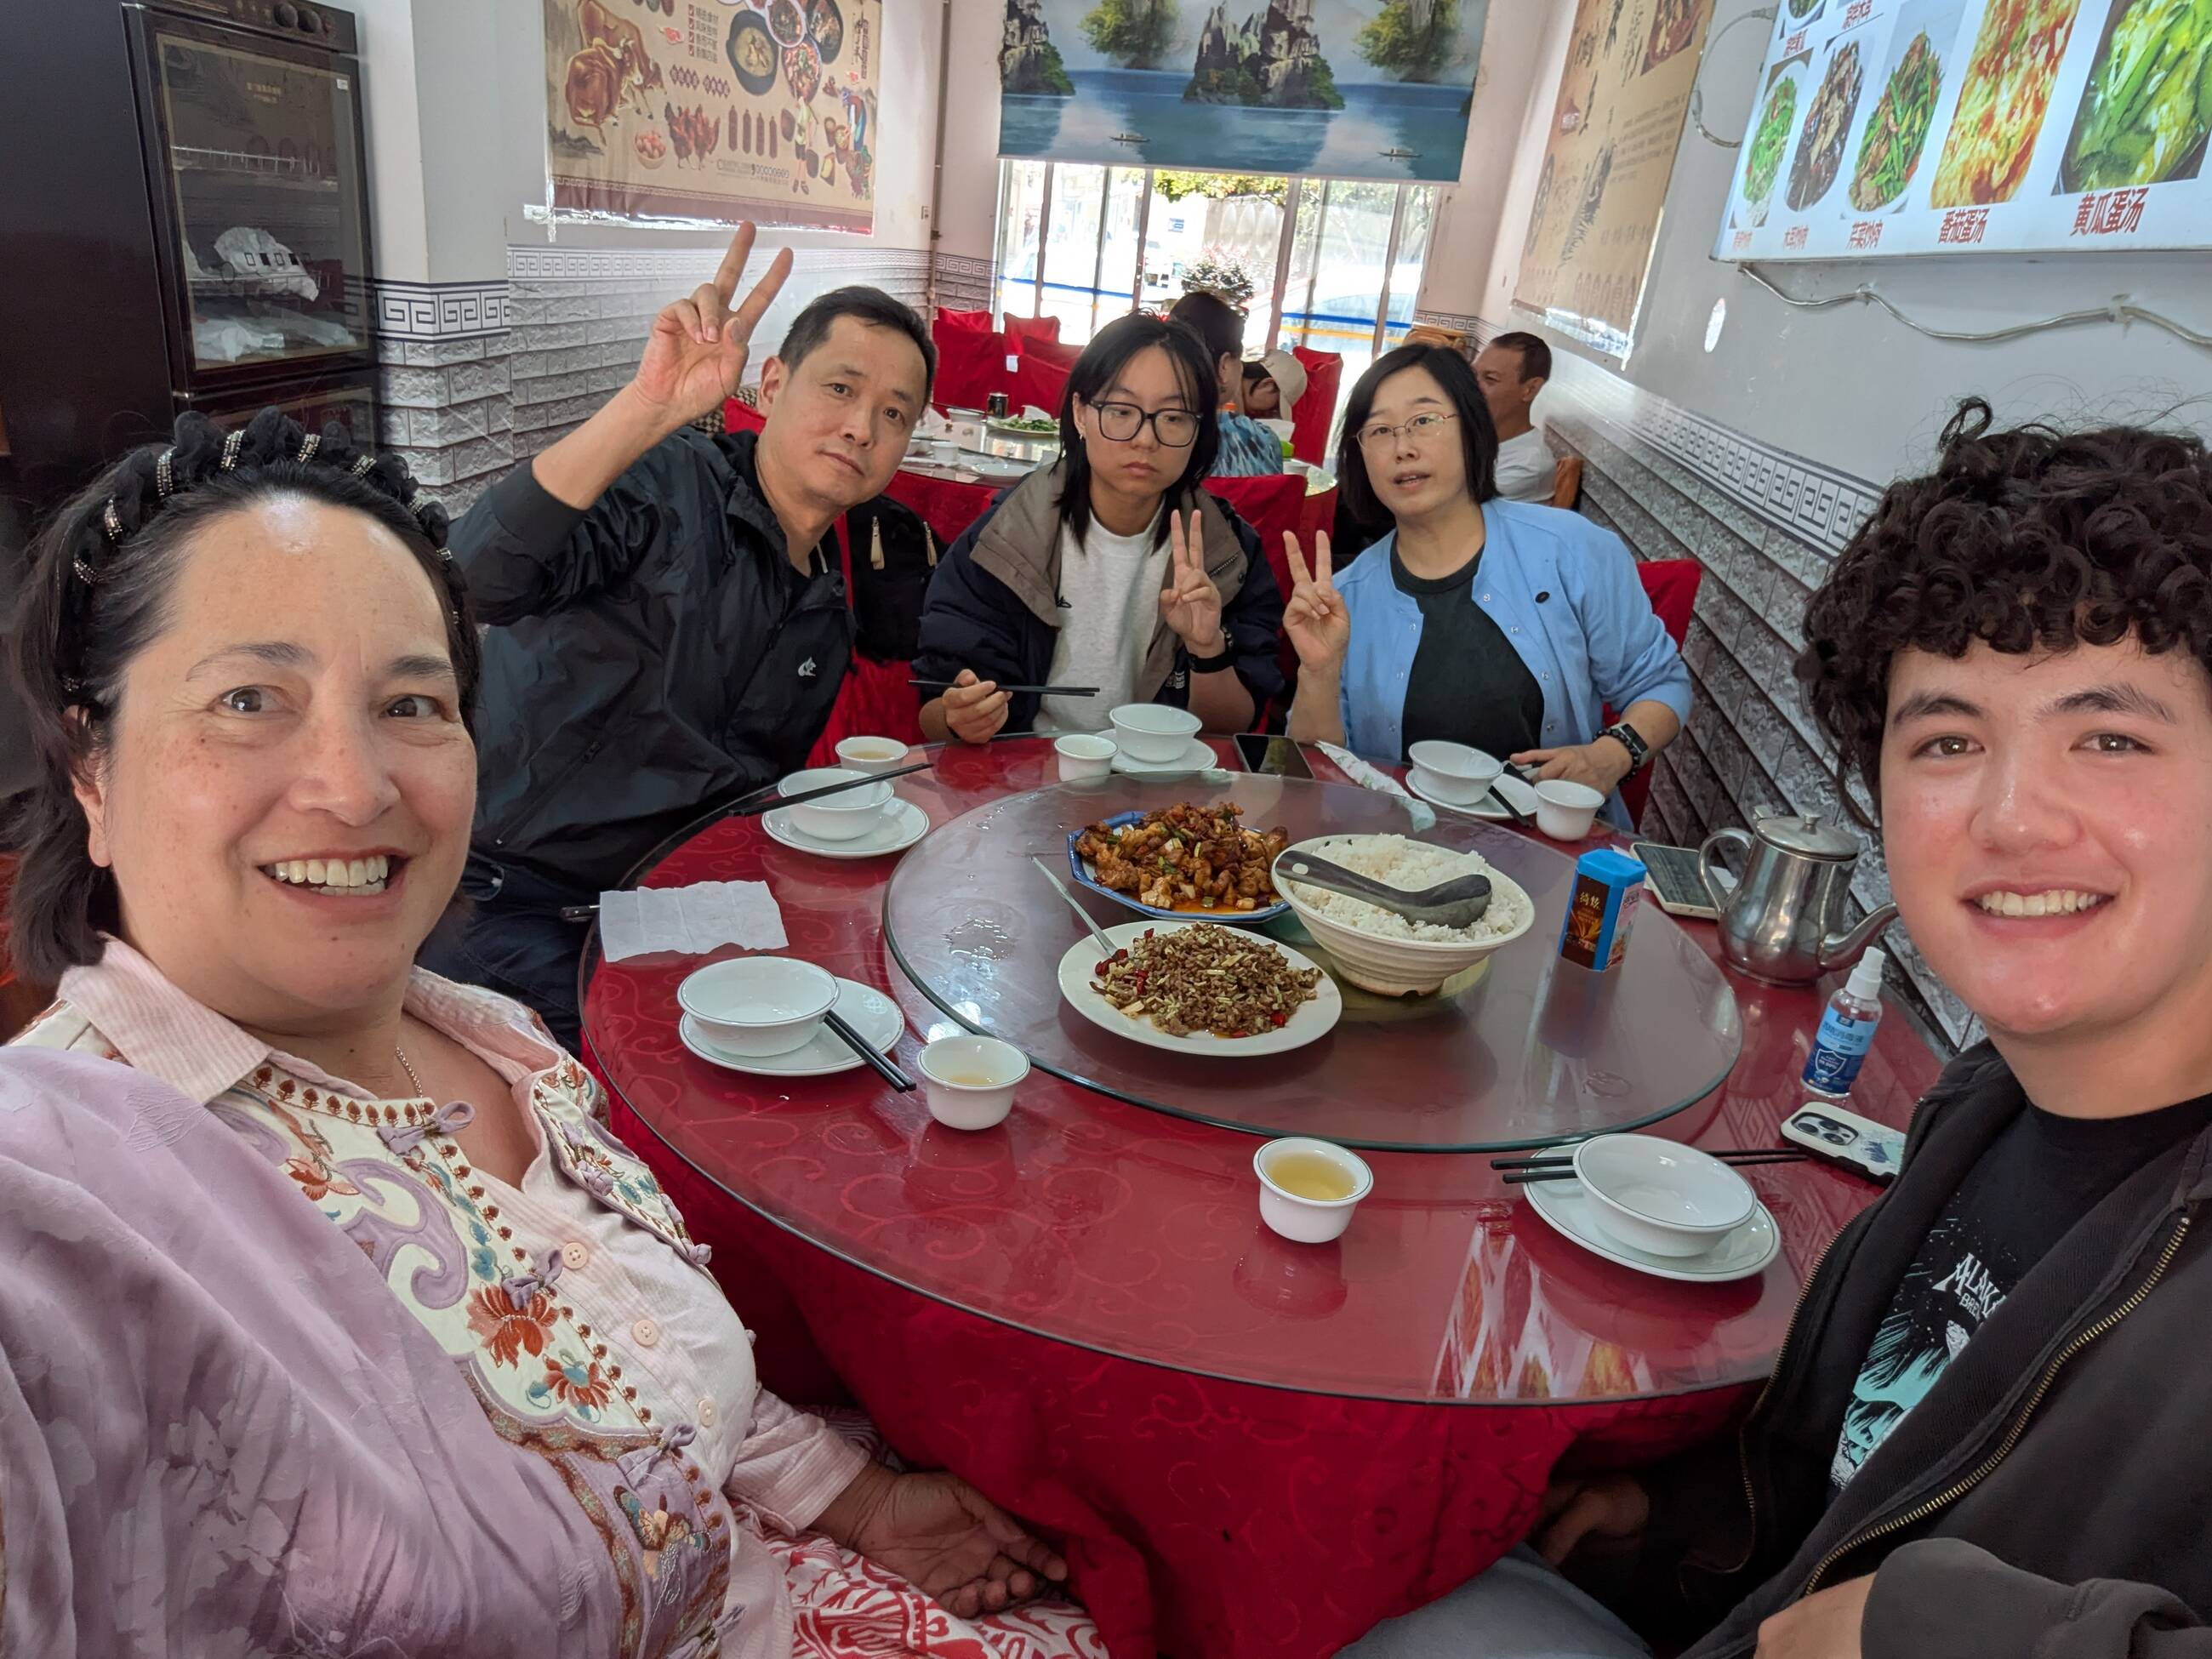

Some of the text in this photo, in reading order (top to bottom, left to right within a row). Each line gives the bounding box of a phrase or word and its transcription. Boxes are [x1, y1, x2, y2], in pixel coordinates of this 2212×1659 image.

[1938, 208, 1990, 244] 番茄蛋汤
[2069, 187, 2149, 237] 黄瓜蛋汤
